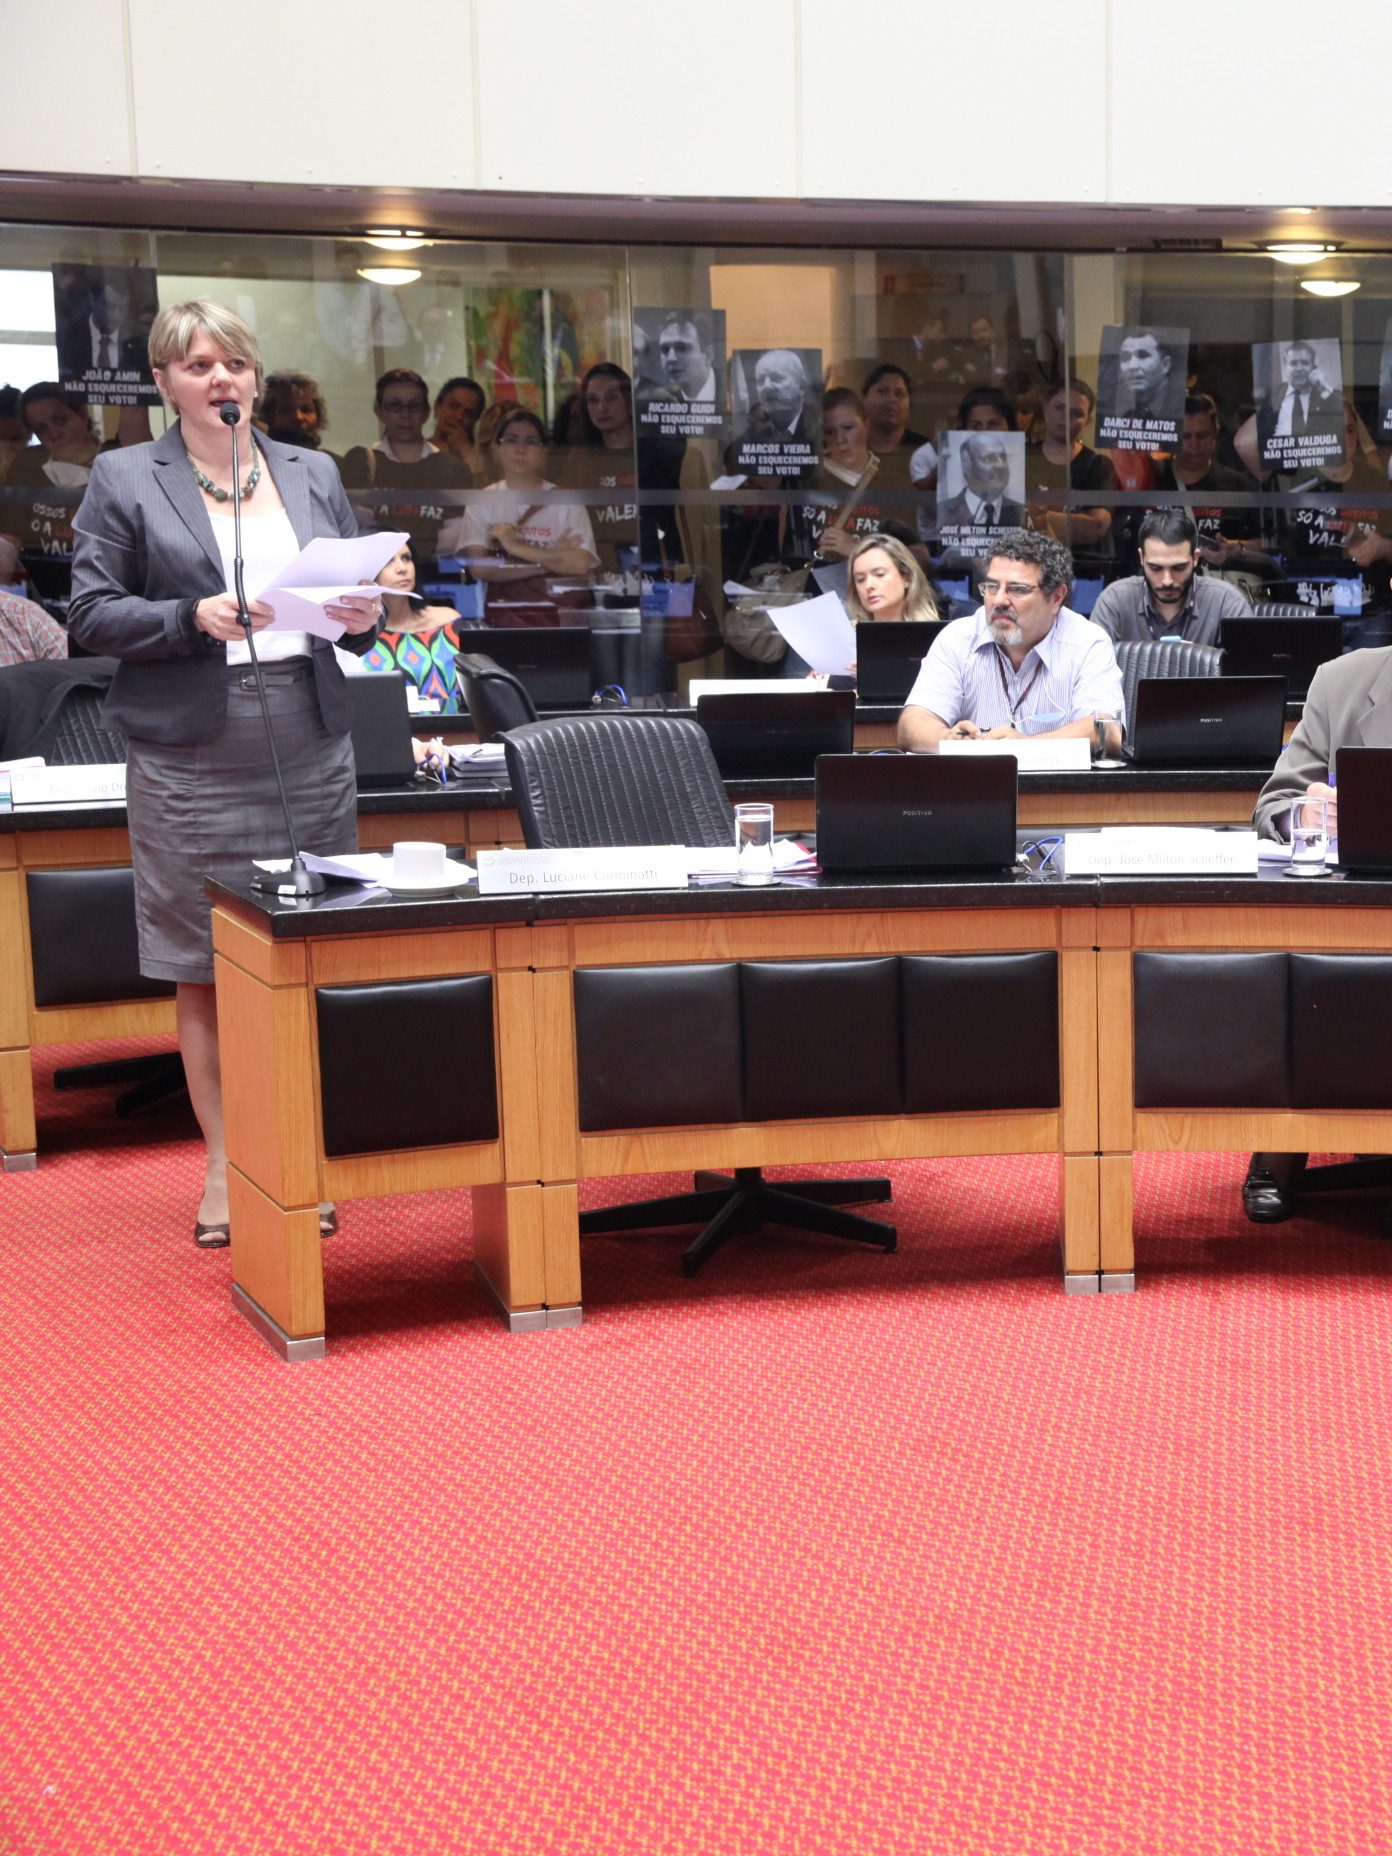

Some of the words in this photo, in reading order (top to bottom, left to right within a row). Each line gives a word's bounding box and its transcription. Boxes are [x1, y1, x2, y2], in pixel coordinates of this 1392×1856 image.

[82, 369, 111, 381] JOÃO
[115, 371, 141, 382] AMIN
[64, 381, 85, 391] NÃO
[88, 382, 157, 394] ESQUECEREMOS
[88, 394, 105, 403] SEU
[108, 395, 137, 405] VOTO!
[648, 402, 688, 413] RICARDO
[690, 404, 715, 414] GUIDI
[641, 413, 659, 423] NÃO
[661, 415, 723, 425] ESQUECEREMOS
[1104, 417, 1130, 428] DARCI
[1132, 419, 1144, 429] DE
[1145, 420, 1176, 431] MATOS
[660, 425, 676, 434] SEU
[678, 426, 704, 435] VOTO!
[1100, 428, 1117, 437] NÃO
[1119, 429, 1178, 442] ESQUECEREMOS
[1118, 440, 1133, 449] SEU
[1135, 442, 1160, 451] VOTO!
[1266, 437, 1295, 449] CESAR
[1298, 434, 1338, 446] VALDUGA
[742, 443, 780, 454] MARCOS
[783, 444, 811, 454] VIEIRA
[1263, 449, 1281, 459] NÃO
[1283, 446, 1342, 458] ESQUECEREMOS
[738, 454, 756, 464] NÃO
[758, 455, 819, 465] ESQUECEREMOS
[1283, 459, 1298, 469] SEU
[1300, 457, 1325, 467] VOTO!
[758, 466, 773, 475] SEU
[776, 466, 801, 475] VOTO!
[420, 505, 444, 519] FAZ
[856, 518, 880, 533] FAZ
[940, 524, 959, 534] JOSÉ
[960, 526, 987, 535] MILTON
[1199, 519, 1221, 531] FAZ
[41, 538, 73, 556] VAL
[941, 536, 960, 547] NÃO
[960, 548, 976, 557] SEU
[1119, 853, 1143, 865] José
[1147, 854, 1185, 865] Milton
[1189, 853, 1235, 865] Scheffer
[509, 872, 538, 887] Dep.
[542, 870, 590, 883] Luciane
[594, 868, 658, 881] Carminatti
